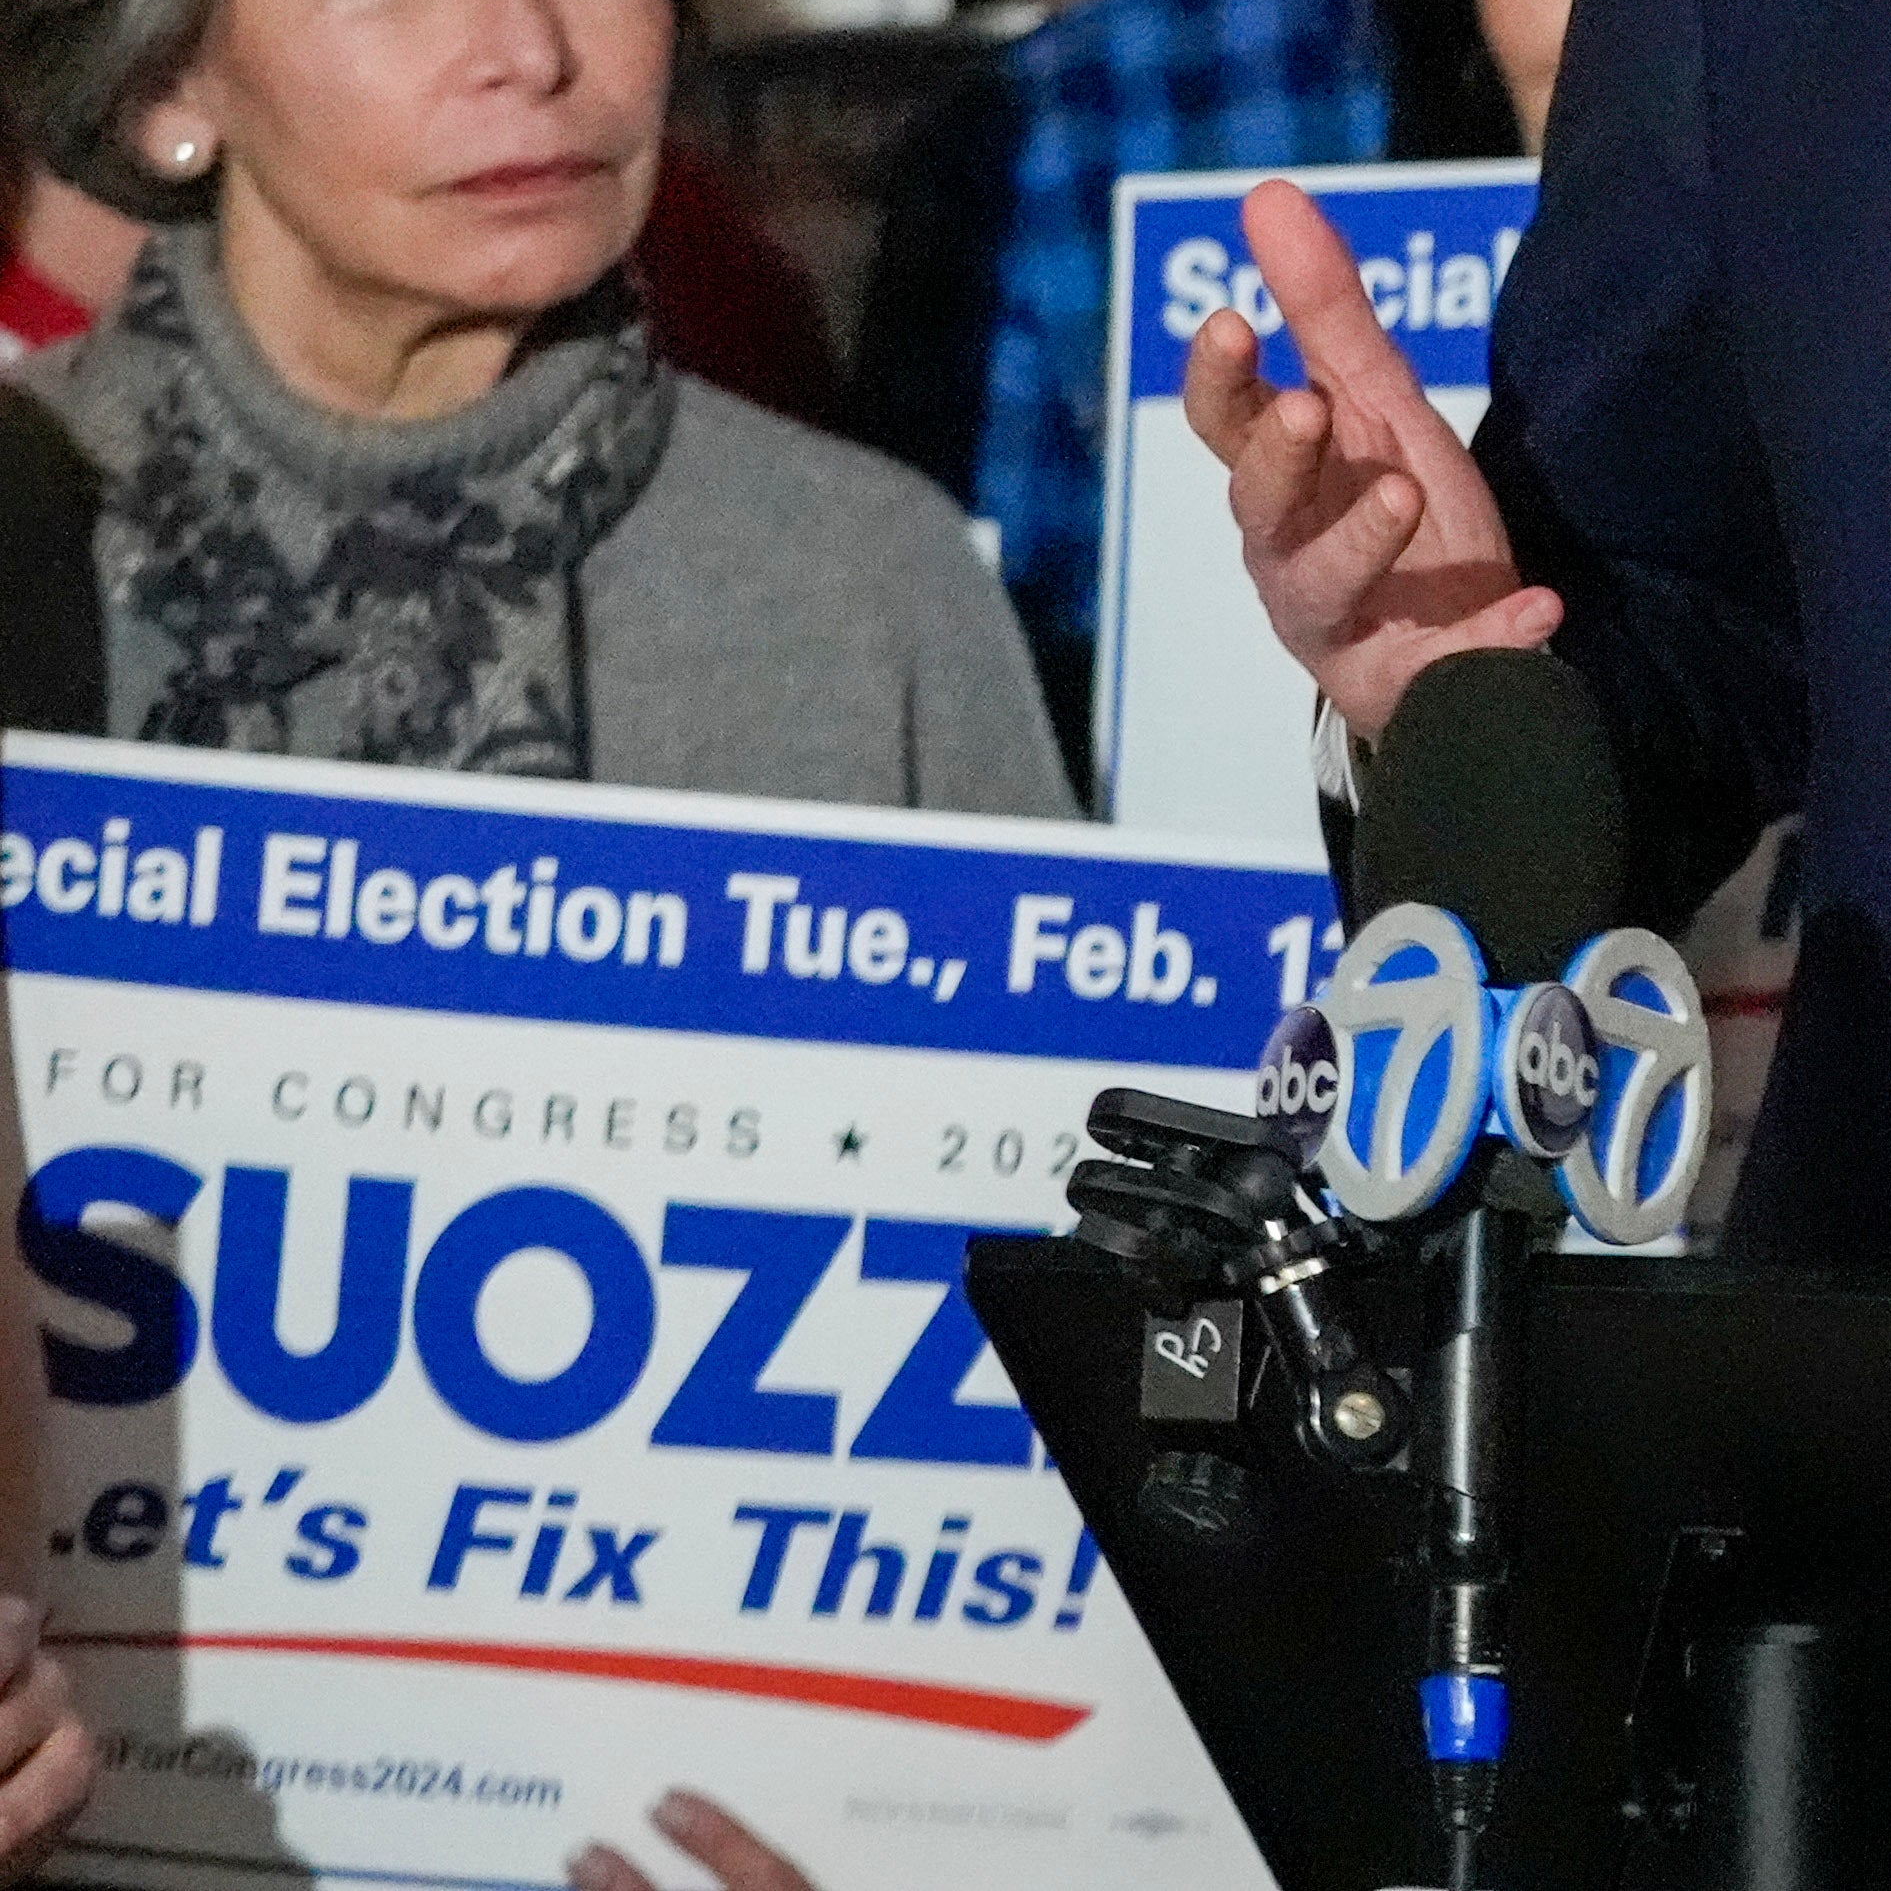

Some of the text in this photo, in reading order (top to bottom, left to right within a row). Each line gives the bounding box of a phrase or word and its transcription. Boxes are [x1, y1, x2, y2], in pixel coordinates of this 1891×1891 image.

[257, 832, 688, 968] Election
[726, 871, 969, 1004] Tue.,
[1006, 894, 1217, 1007] Feb.
[44, 1046, 1080, 1177] FOR CONGRESS 202
[1256, 1046, 1338, 1116] abc
[1518, 1020, 1600, 1107] abc
[16, 1145, 1066, 1471] SUOZZ
[427, 1484, 667, 1607] Fix
[732, 1502, 1101, 1632] This!
